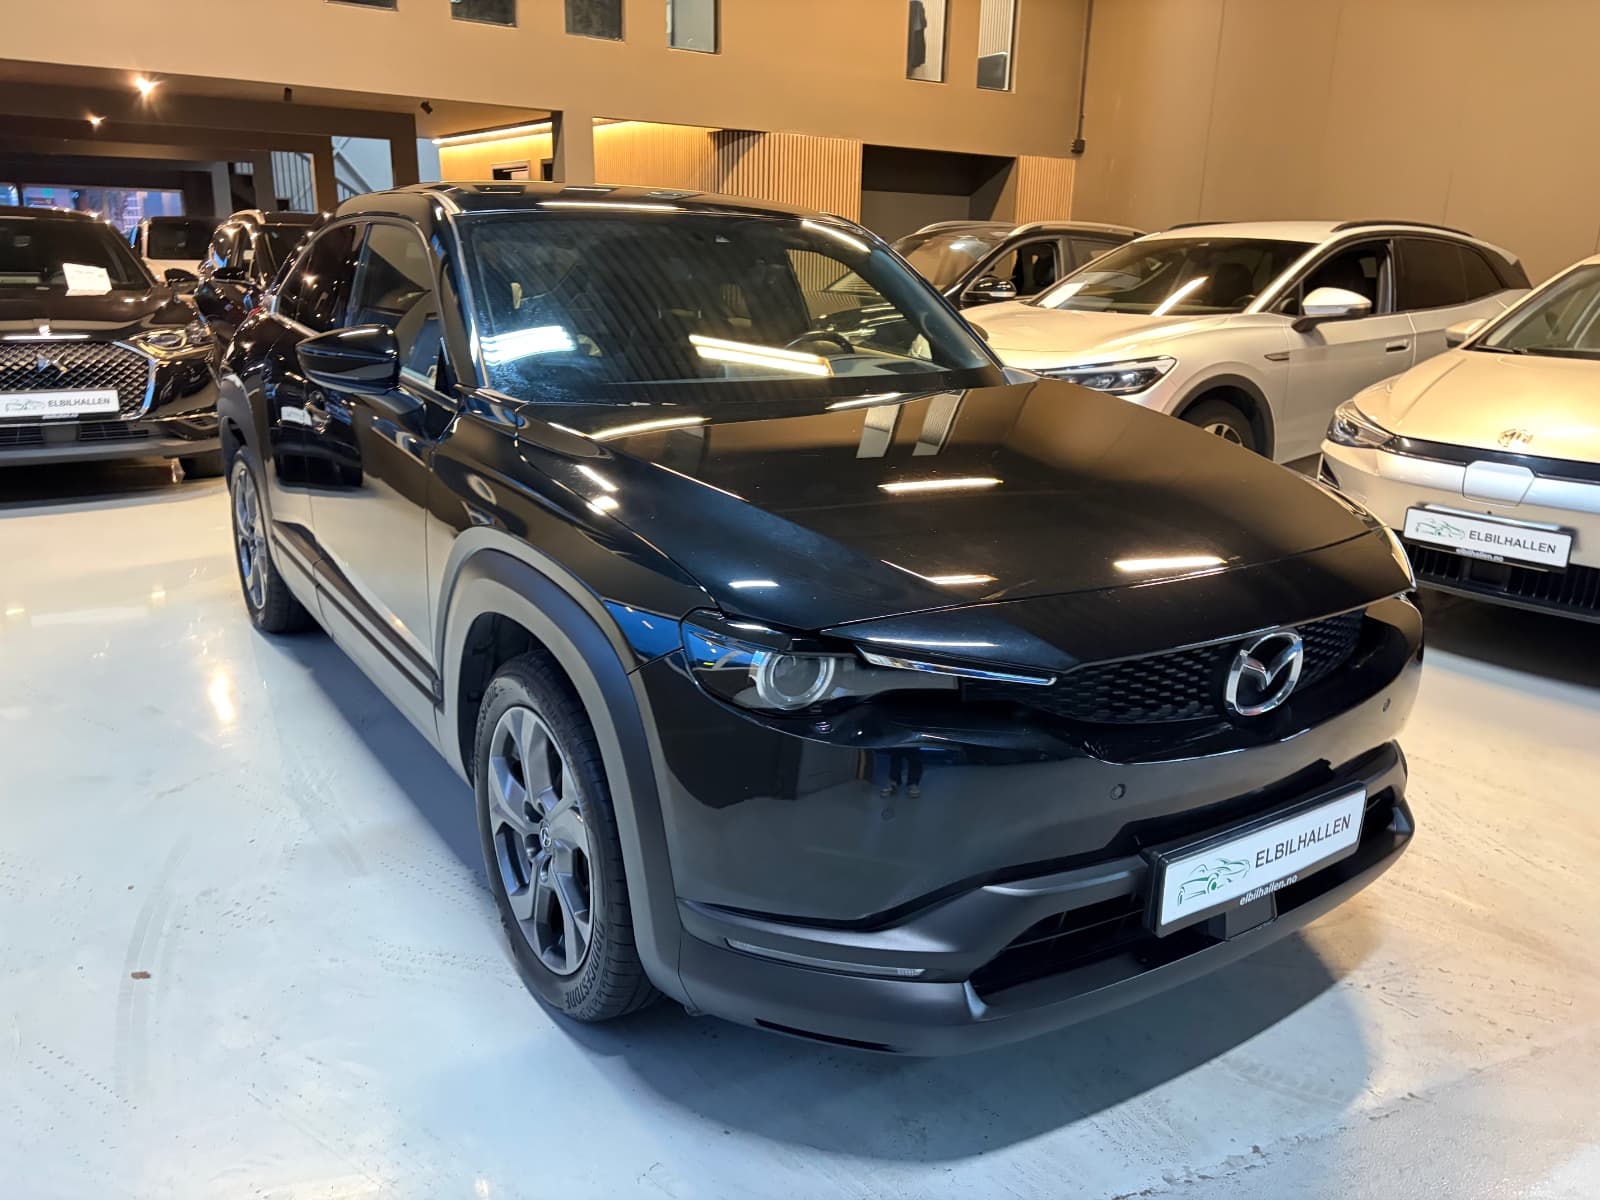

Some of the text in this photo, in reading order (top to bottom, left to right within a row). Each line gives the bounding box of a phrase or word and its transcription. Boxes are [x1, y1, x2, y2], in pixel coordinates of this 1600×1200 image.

[48, 398, 110, 408] ELBILHALLEN
[1469, 530, 1557, 554] ELBILHALLEN
[1255, 813, 1352, 869] ELBILHALLEN
[1239, 874, 1298, 906] elbilhallen.no
